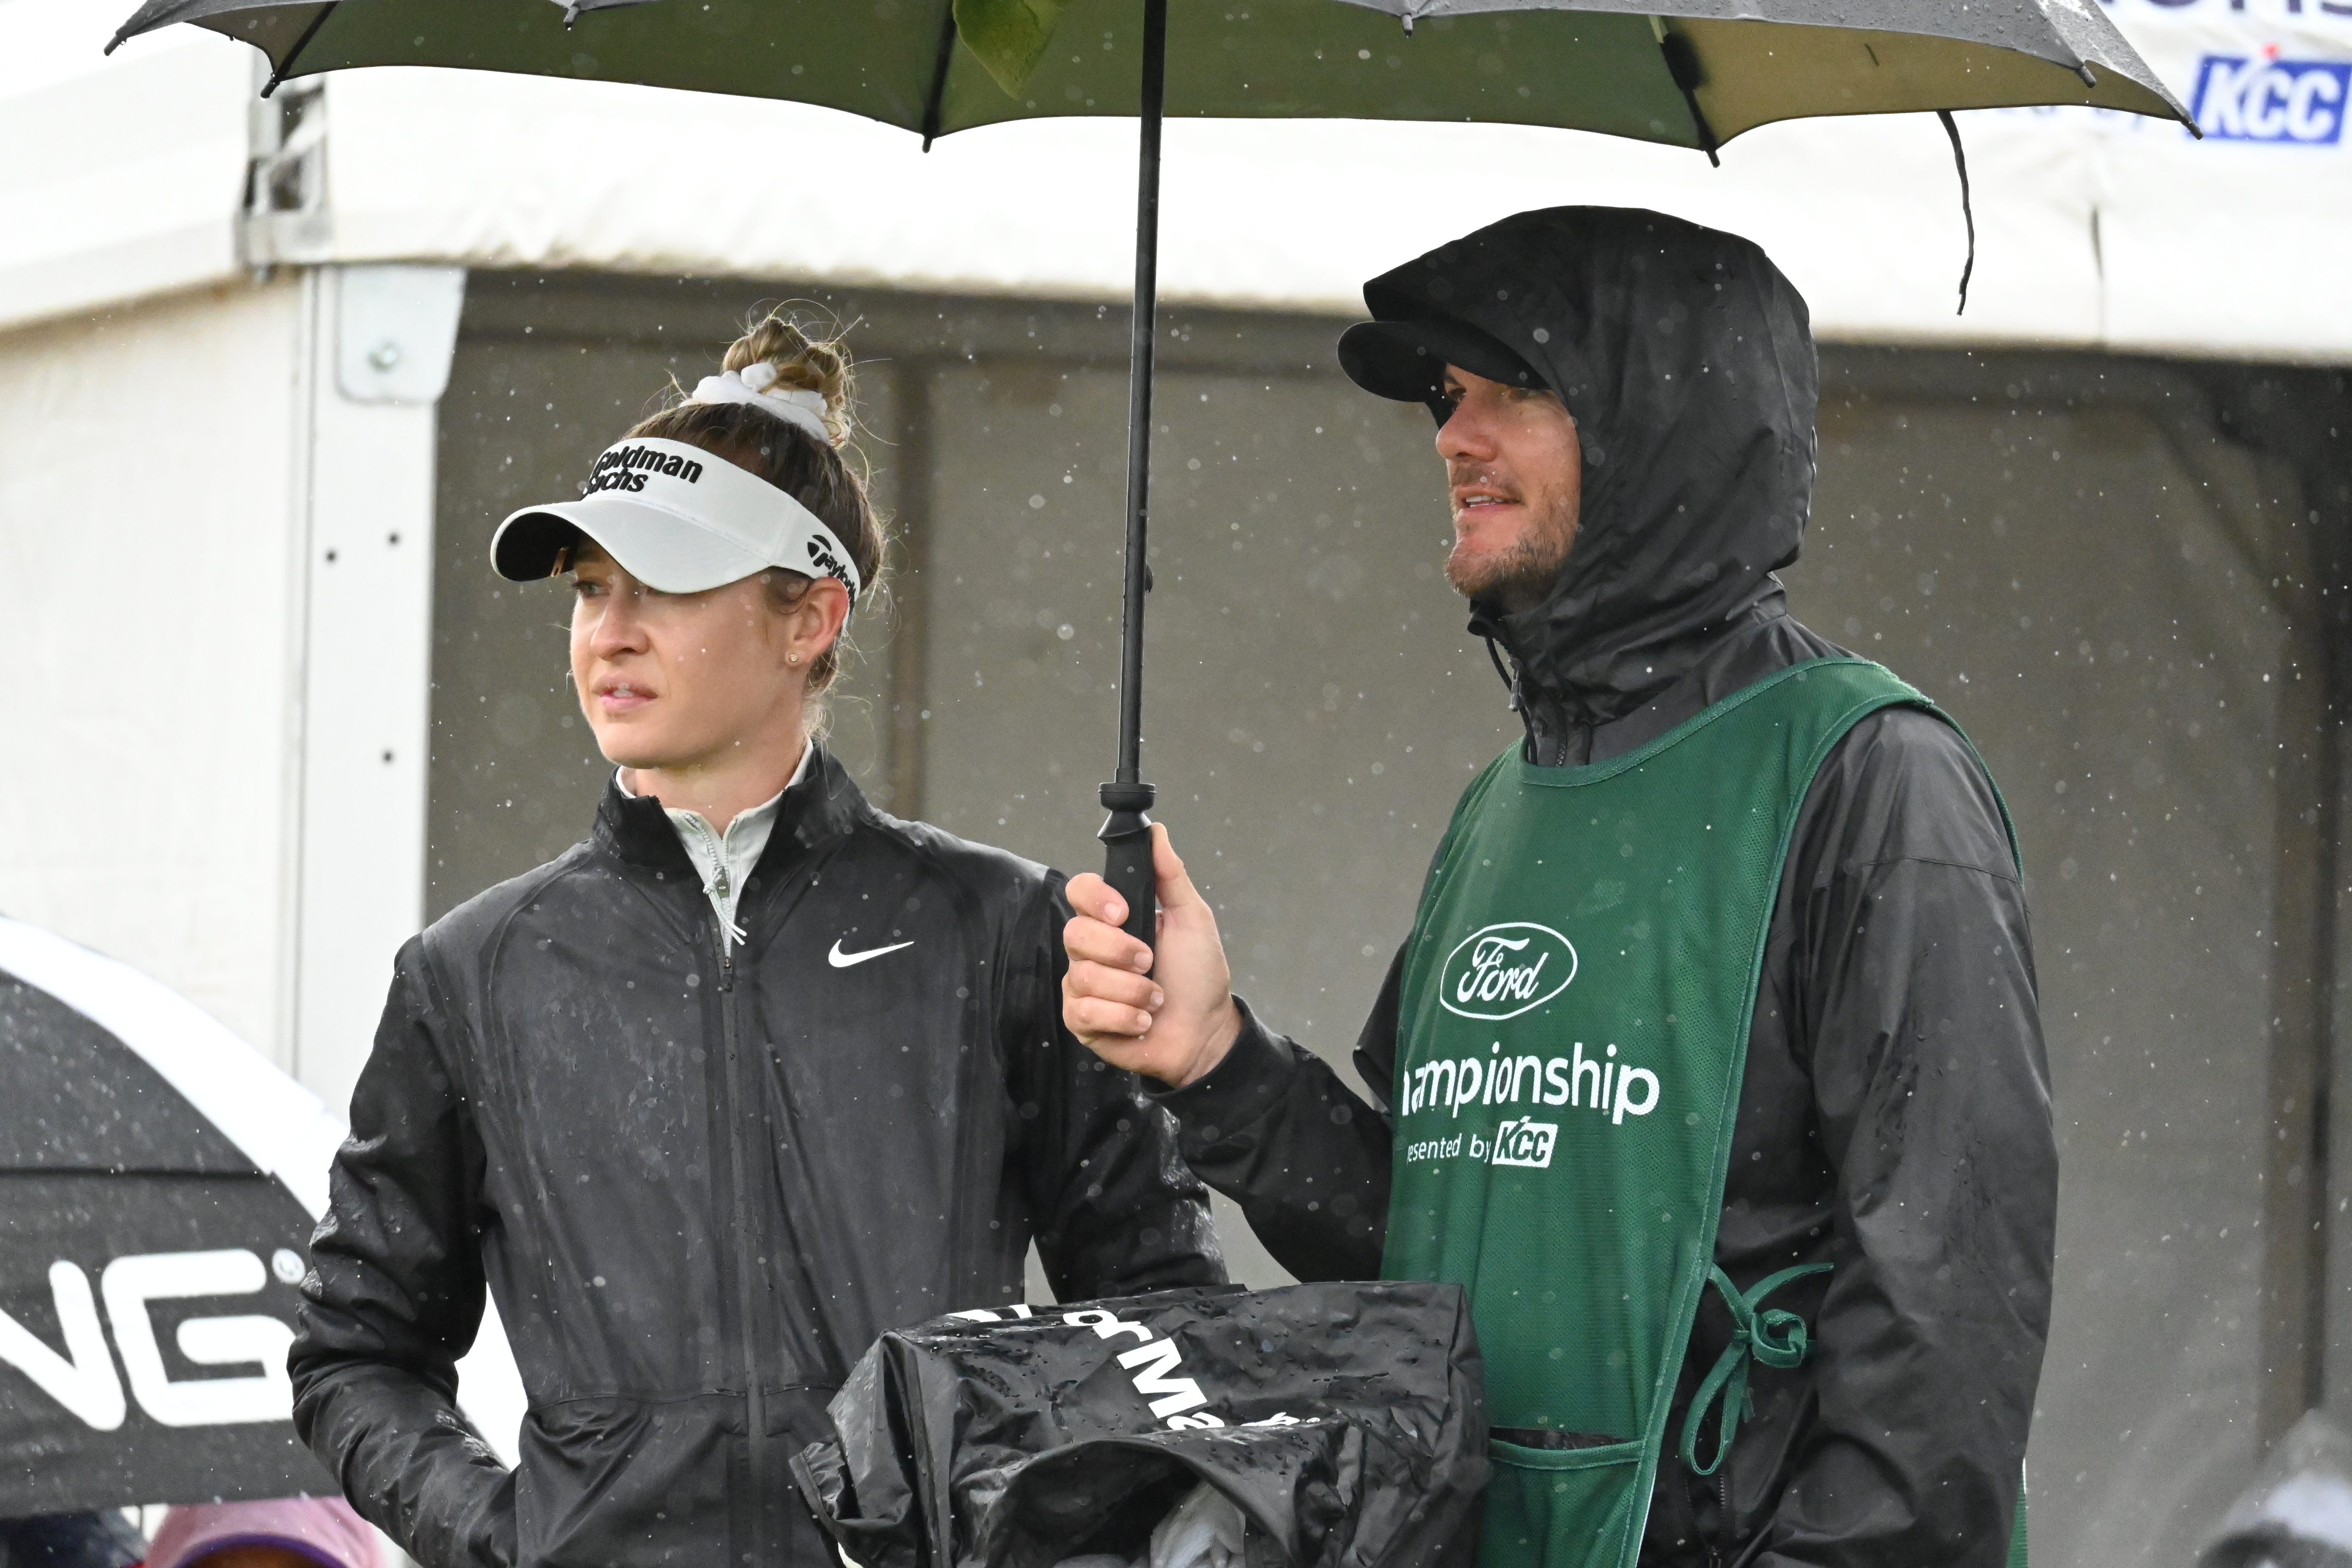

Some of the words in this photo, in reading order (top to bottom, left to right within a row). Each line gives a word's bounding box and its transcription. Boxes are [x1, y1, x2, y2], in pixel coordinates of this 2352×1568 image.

[2200, 60, 2341, 140] KCC
[1456, 936, 1549, 1003] Ford
[1407, 1133, 1462, 1165] esented
[1469, 1134, 1492, 1162] by
[1496, 1121, 1551, 1162] KCC
